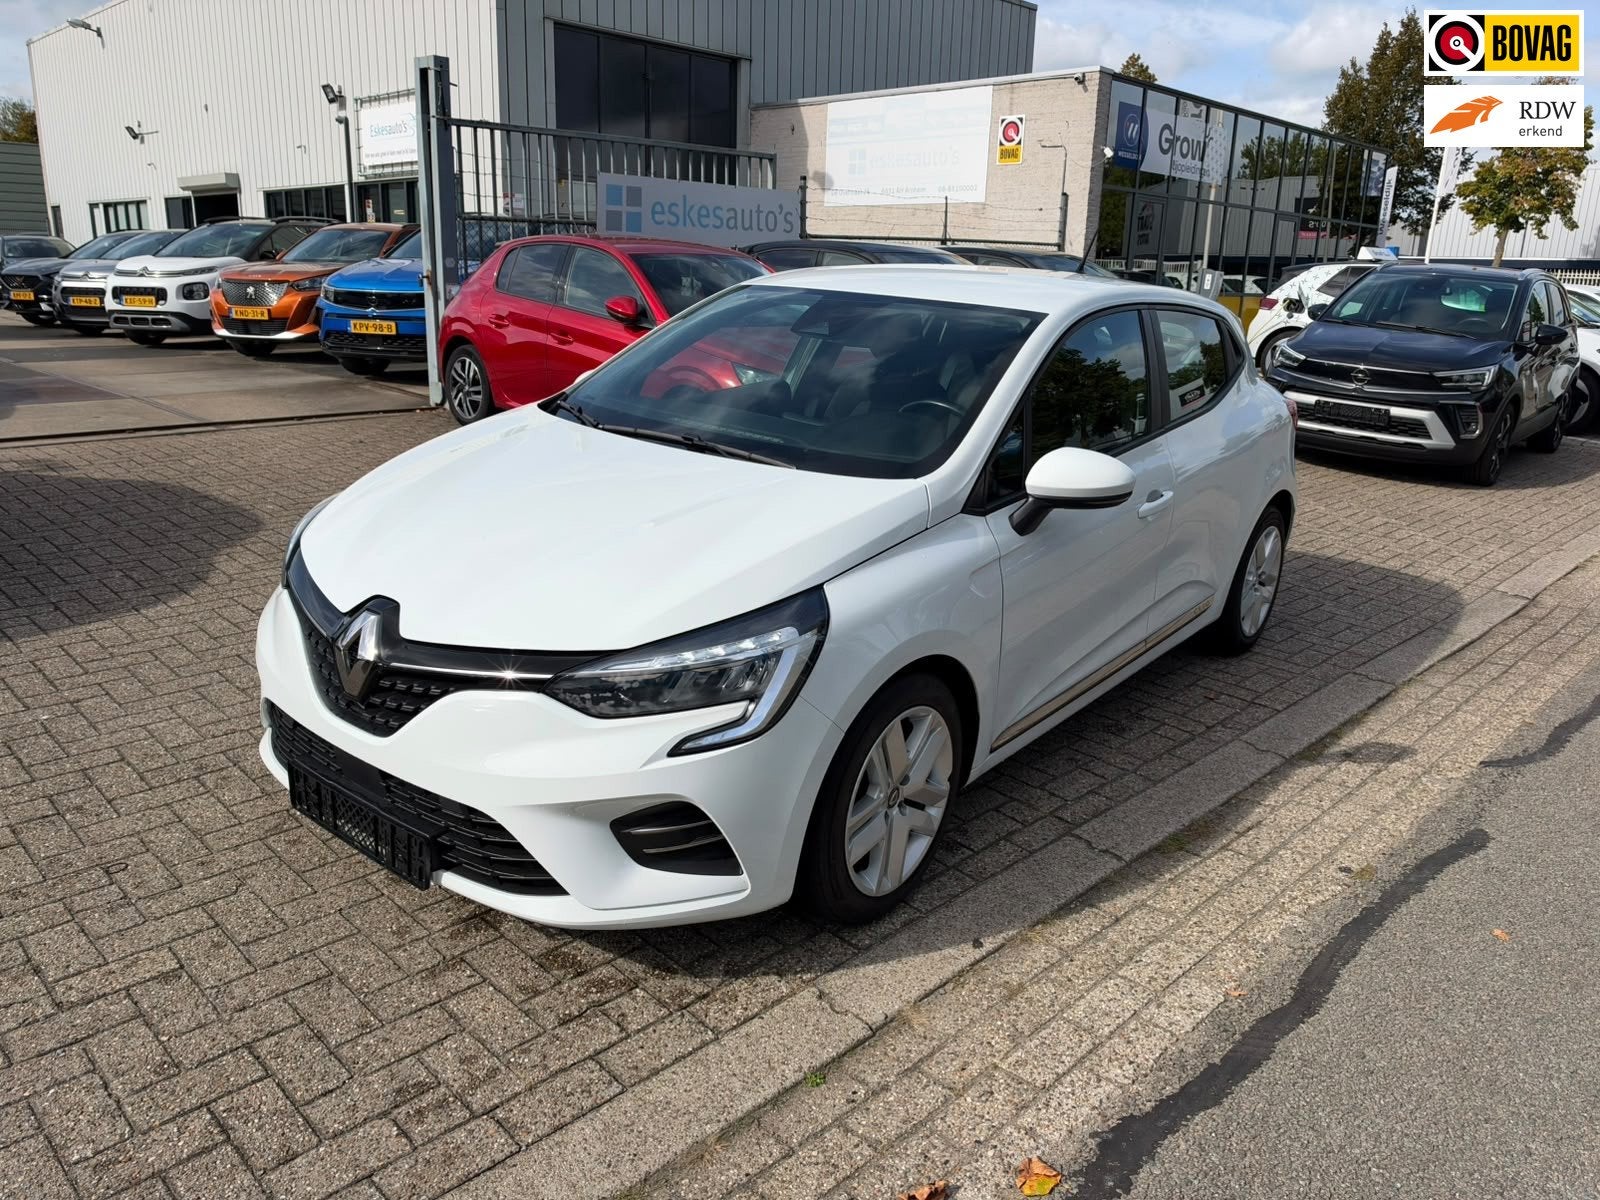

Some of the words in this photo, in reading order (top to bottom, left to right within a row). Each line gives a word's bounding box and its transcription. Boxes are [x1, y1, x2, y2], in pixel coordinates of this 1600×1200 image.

[999, 147, 1020, 160] BOVAG
[1378, 178, 1393, 235] Wesseldijk
[650, 194, 795, 234] eskesauto's
[234, 309, 265, 319] KND-31-R
[352, 321, 393, 333] KPV-98-B
